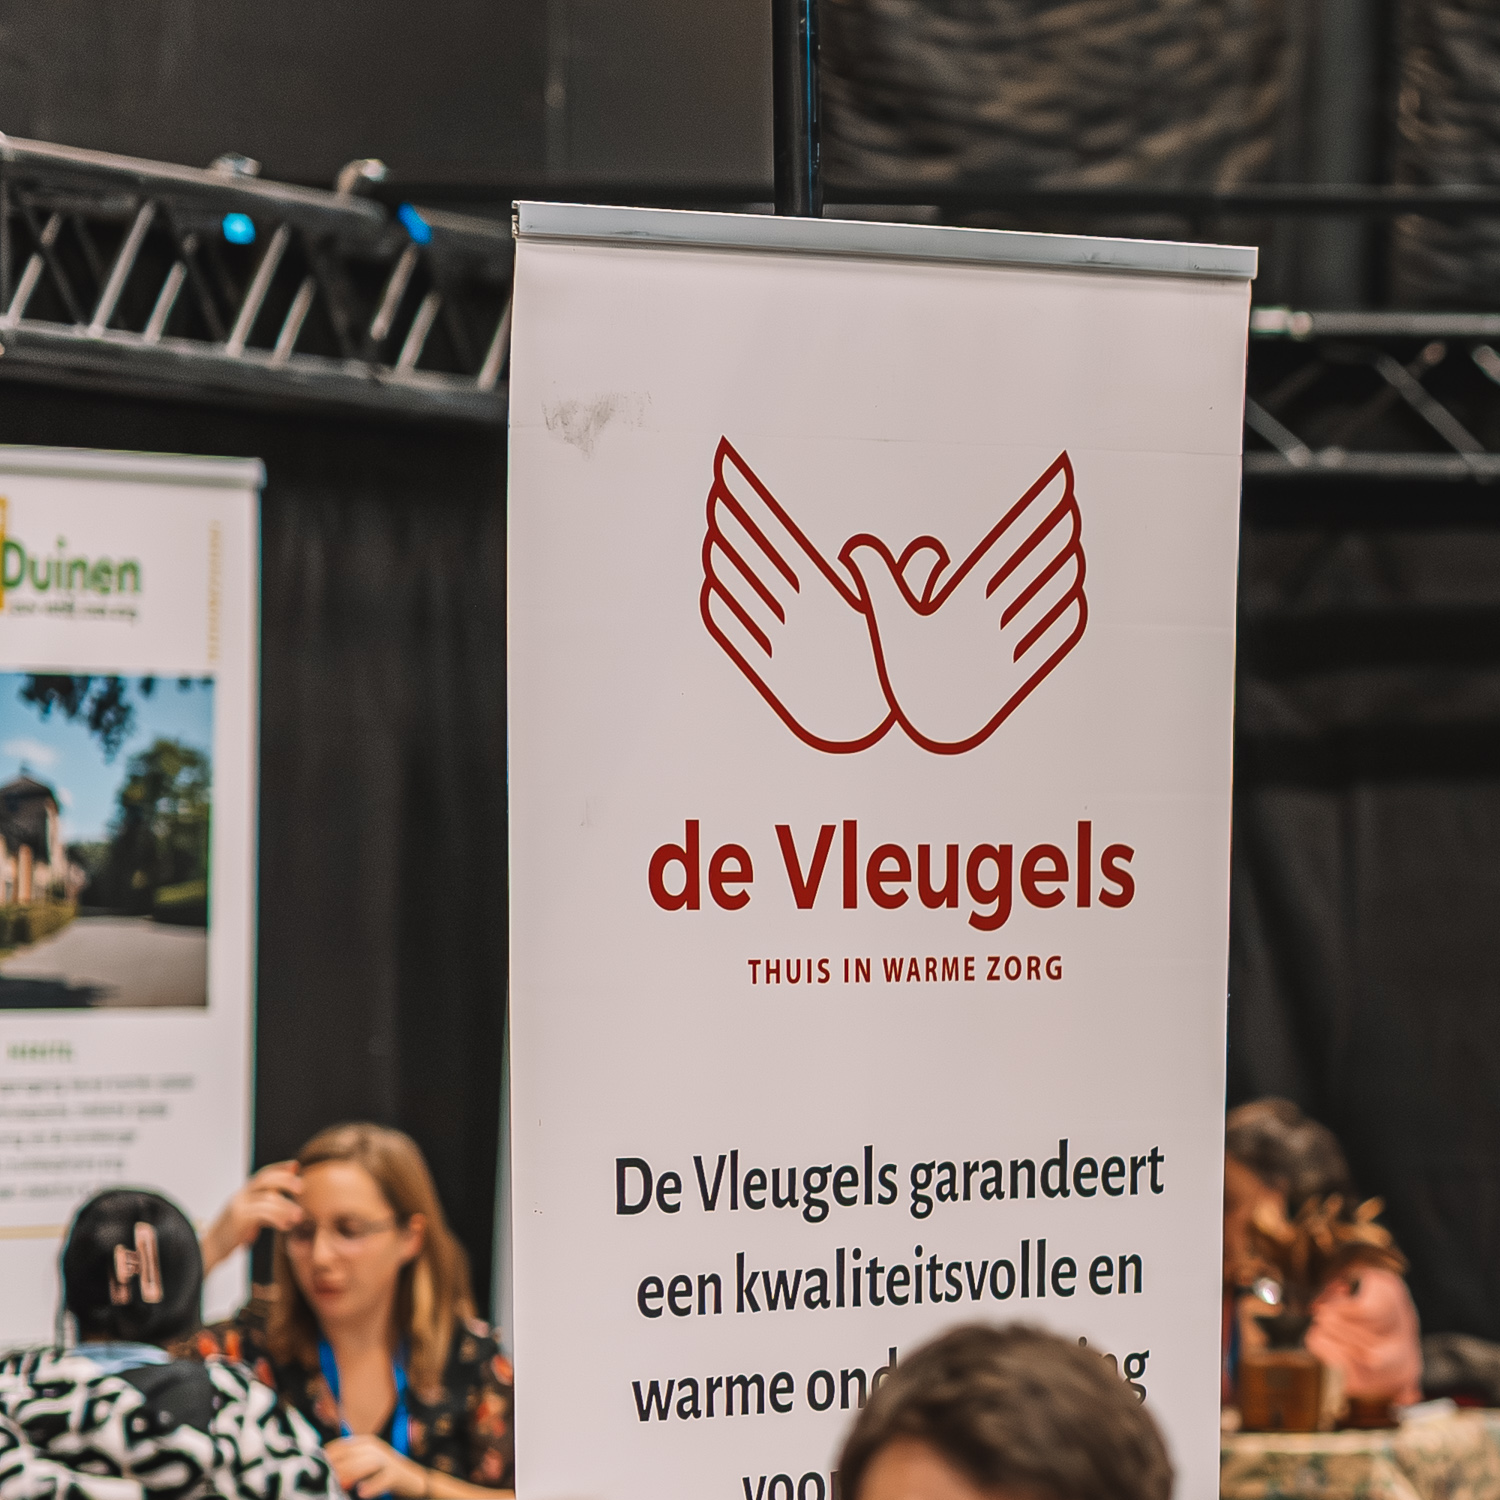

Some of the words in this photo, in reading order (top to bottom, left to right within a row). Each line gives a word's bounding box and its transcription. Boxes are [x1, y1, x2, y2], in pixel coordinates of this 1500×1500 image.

[648, 820, 754, 912] de
[775, 820, 1136, 932] Vleugels
[748, 958, 831, 985] THUIS
[843, 957, 871, 984] IN
[882, 956, 976, 983] WARME
[986, 955, 1063, 982] ZORG
[615, 1157, 683, 1216] De
[693, 1145, 898, 1224] Vleugels
[910, 1138, 1165, 1220] garandeert
[637, 1272, 724, 1319] een
[735, 1238, 1077, 1314] kwaliteitsvolle
[1088, 1252, 1144, 1296] en
[631, 1371, 795, 1422] warme
